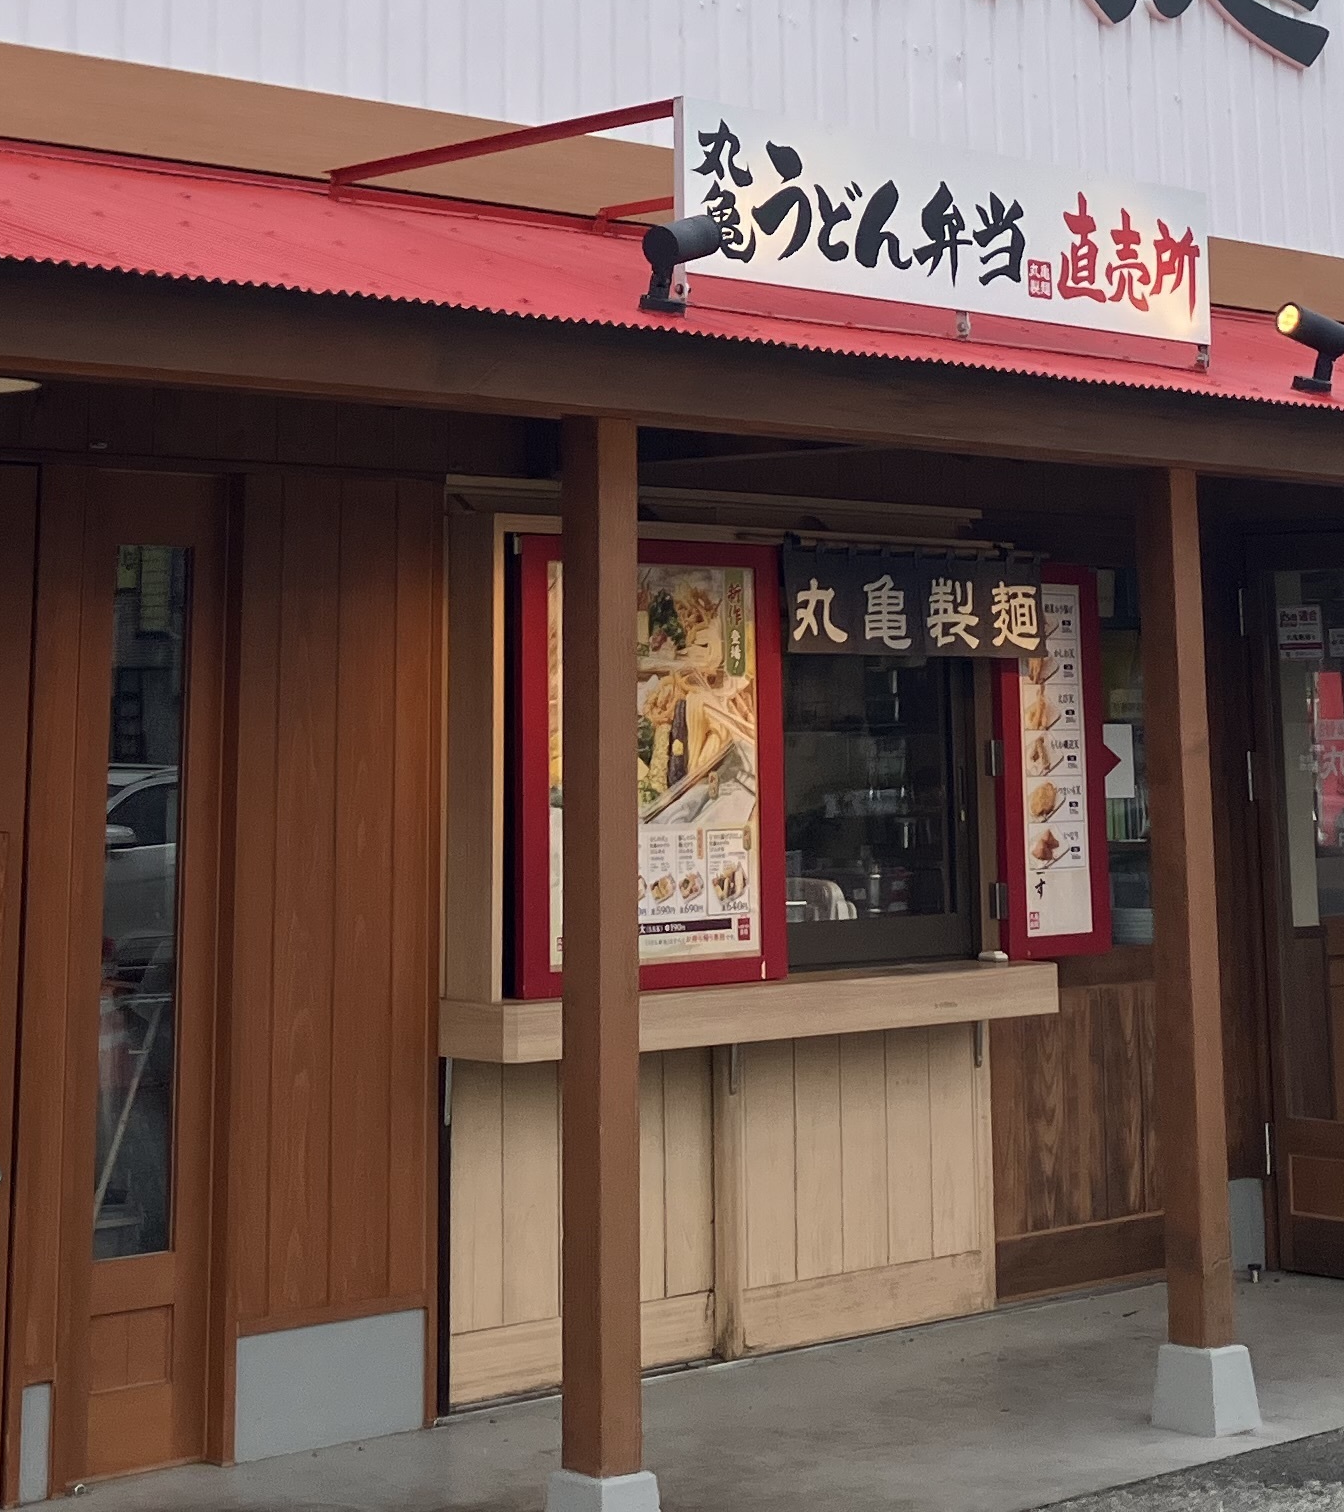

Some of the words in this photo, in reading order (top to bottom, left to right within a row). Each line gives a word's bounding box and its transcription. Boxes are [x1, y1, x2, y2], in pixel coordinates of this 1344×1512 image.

[1057, 191, 1201, 323] 直売所
[793, 574, 1041, 652] 丸亀製麺
